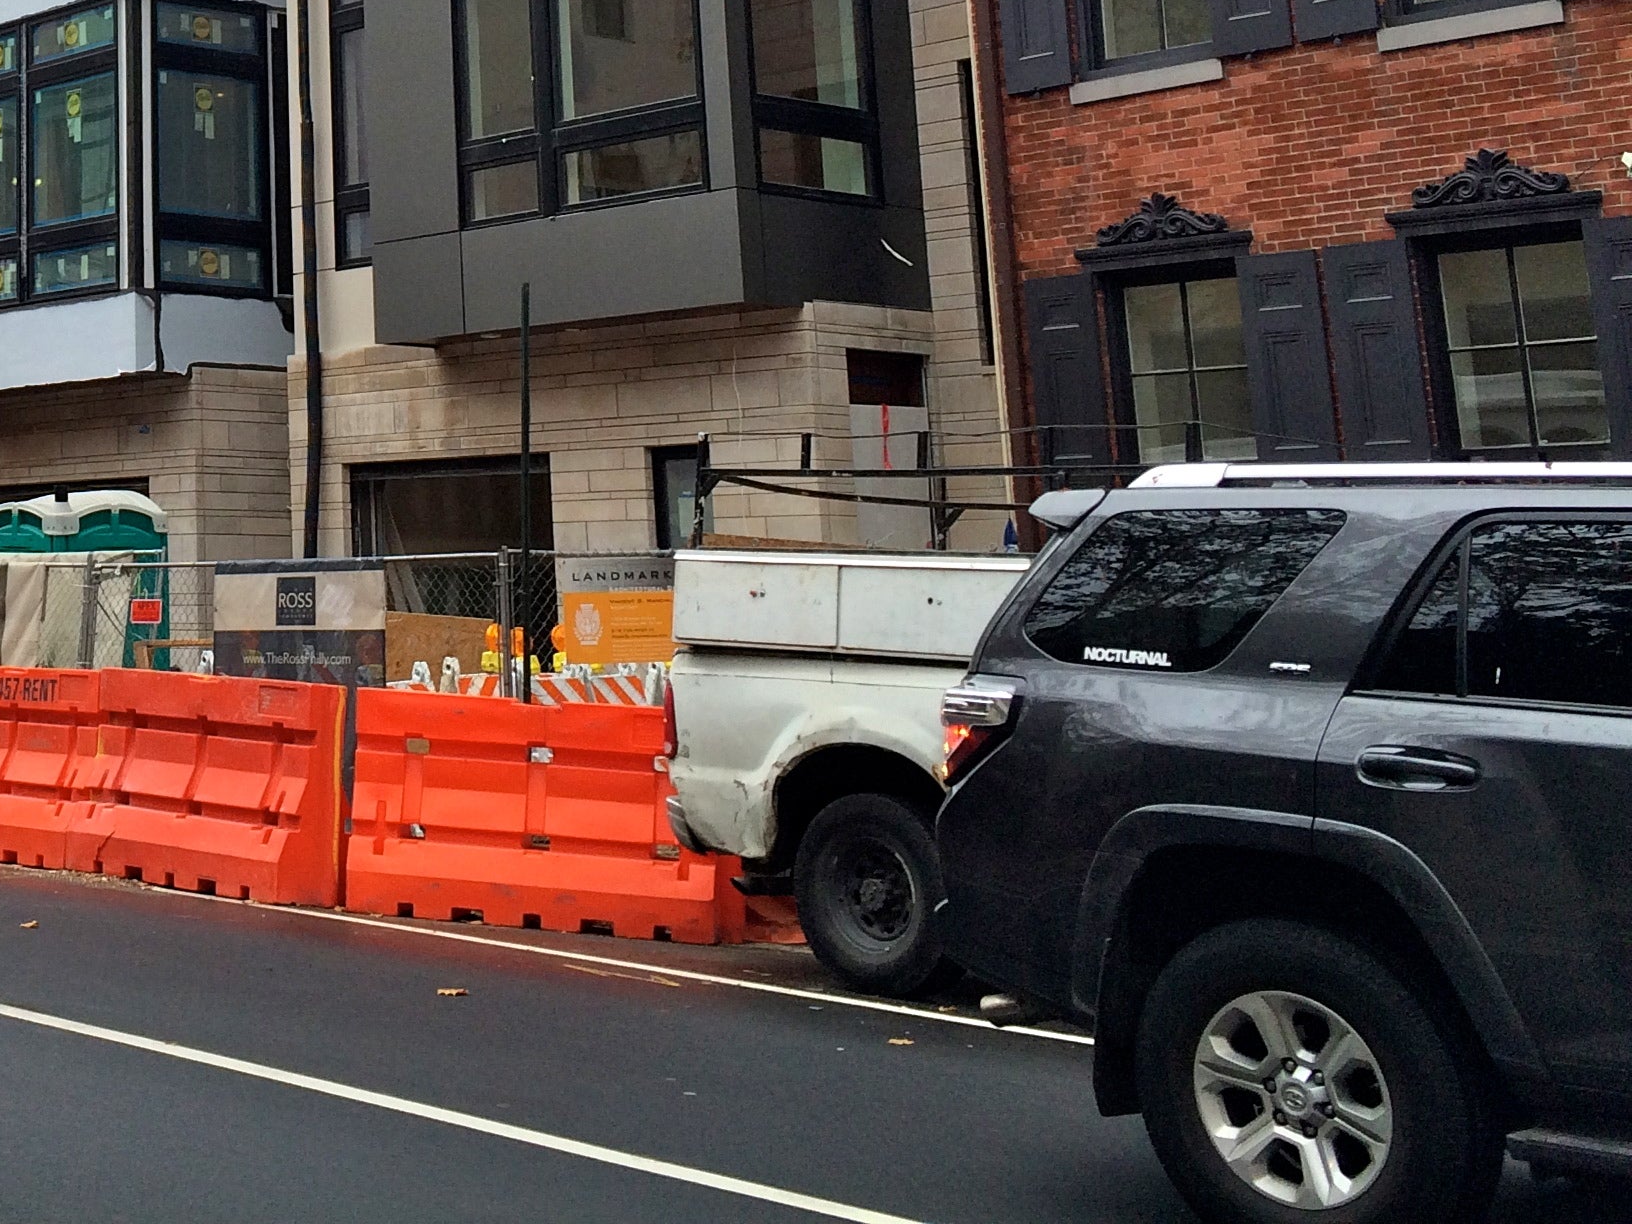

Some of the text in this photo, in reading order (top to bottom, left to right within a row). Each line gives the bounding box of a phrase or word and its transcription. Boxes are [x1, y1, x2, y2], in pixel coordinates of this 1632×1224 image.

[571, 570, 673, 582] LANDMARK
[278, 591, 314, 609] ROSS
[242, 651, 352, 668] www.TheRossPhilly.com
[1083, 646, 1172, 667] NOCTURNAL
